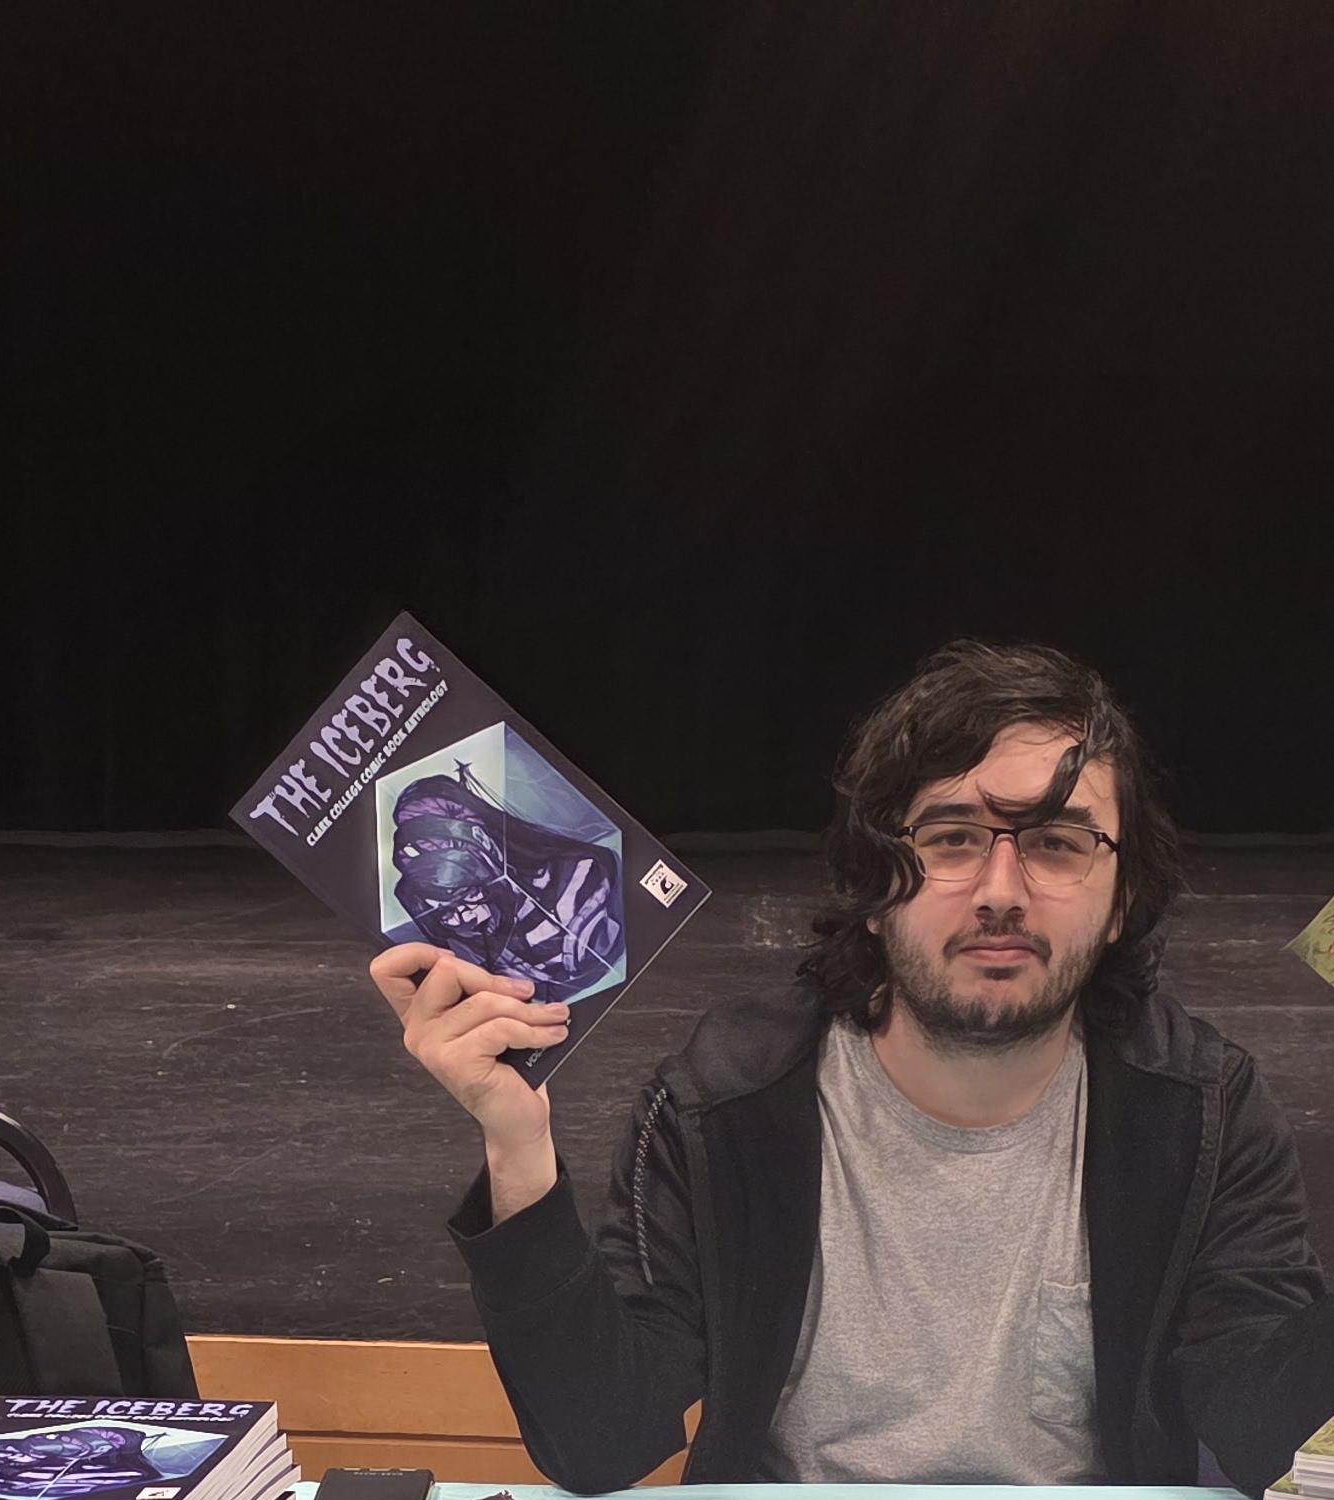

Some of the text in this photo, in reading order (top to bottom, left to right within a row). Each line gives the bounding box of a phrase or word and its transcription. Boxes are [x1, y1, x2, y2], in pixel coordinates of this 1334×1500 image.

[249, 638, 441, 837] THE ICEBERG
[306, 816, 333, 847] CLARK
[329, 779, 363, 820] COLLEGE
[360, 752, 387, 784] COMIC
[382, 728, 408, 757] BOOK
[5, 1399, 254, 1418] THE ICEBERG
